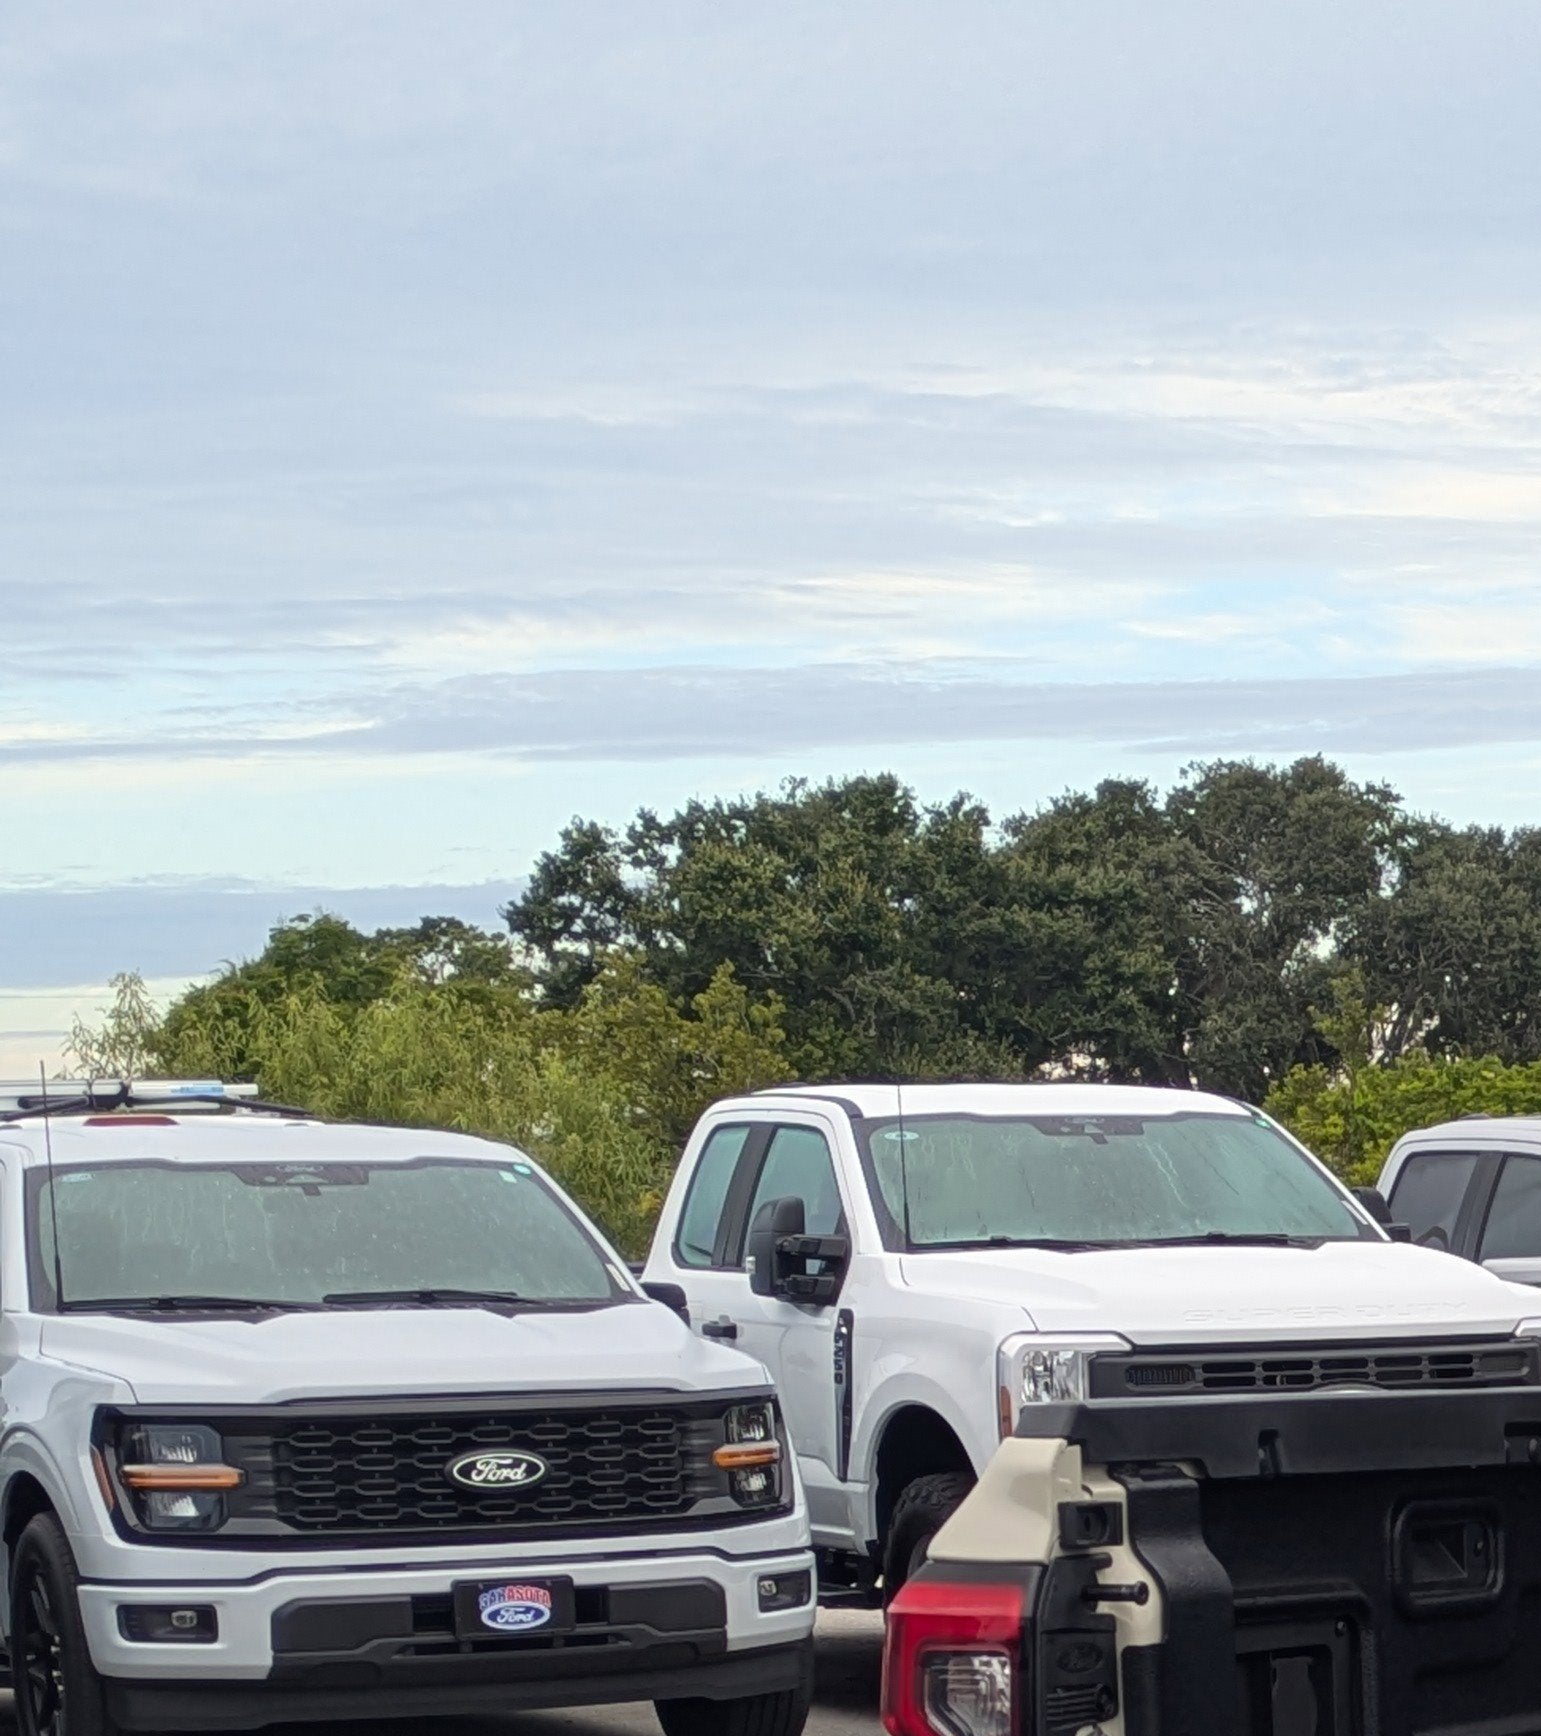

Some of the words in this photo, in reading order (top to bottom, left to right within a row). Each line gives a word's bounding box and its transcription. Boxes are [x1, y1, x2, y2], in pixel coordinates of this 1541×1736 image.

[471, 1457, 527, 1482] Ford
[478, 1585, 552, 1610] SARASOTA
[497, 1607, 534, 1624] Ford
